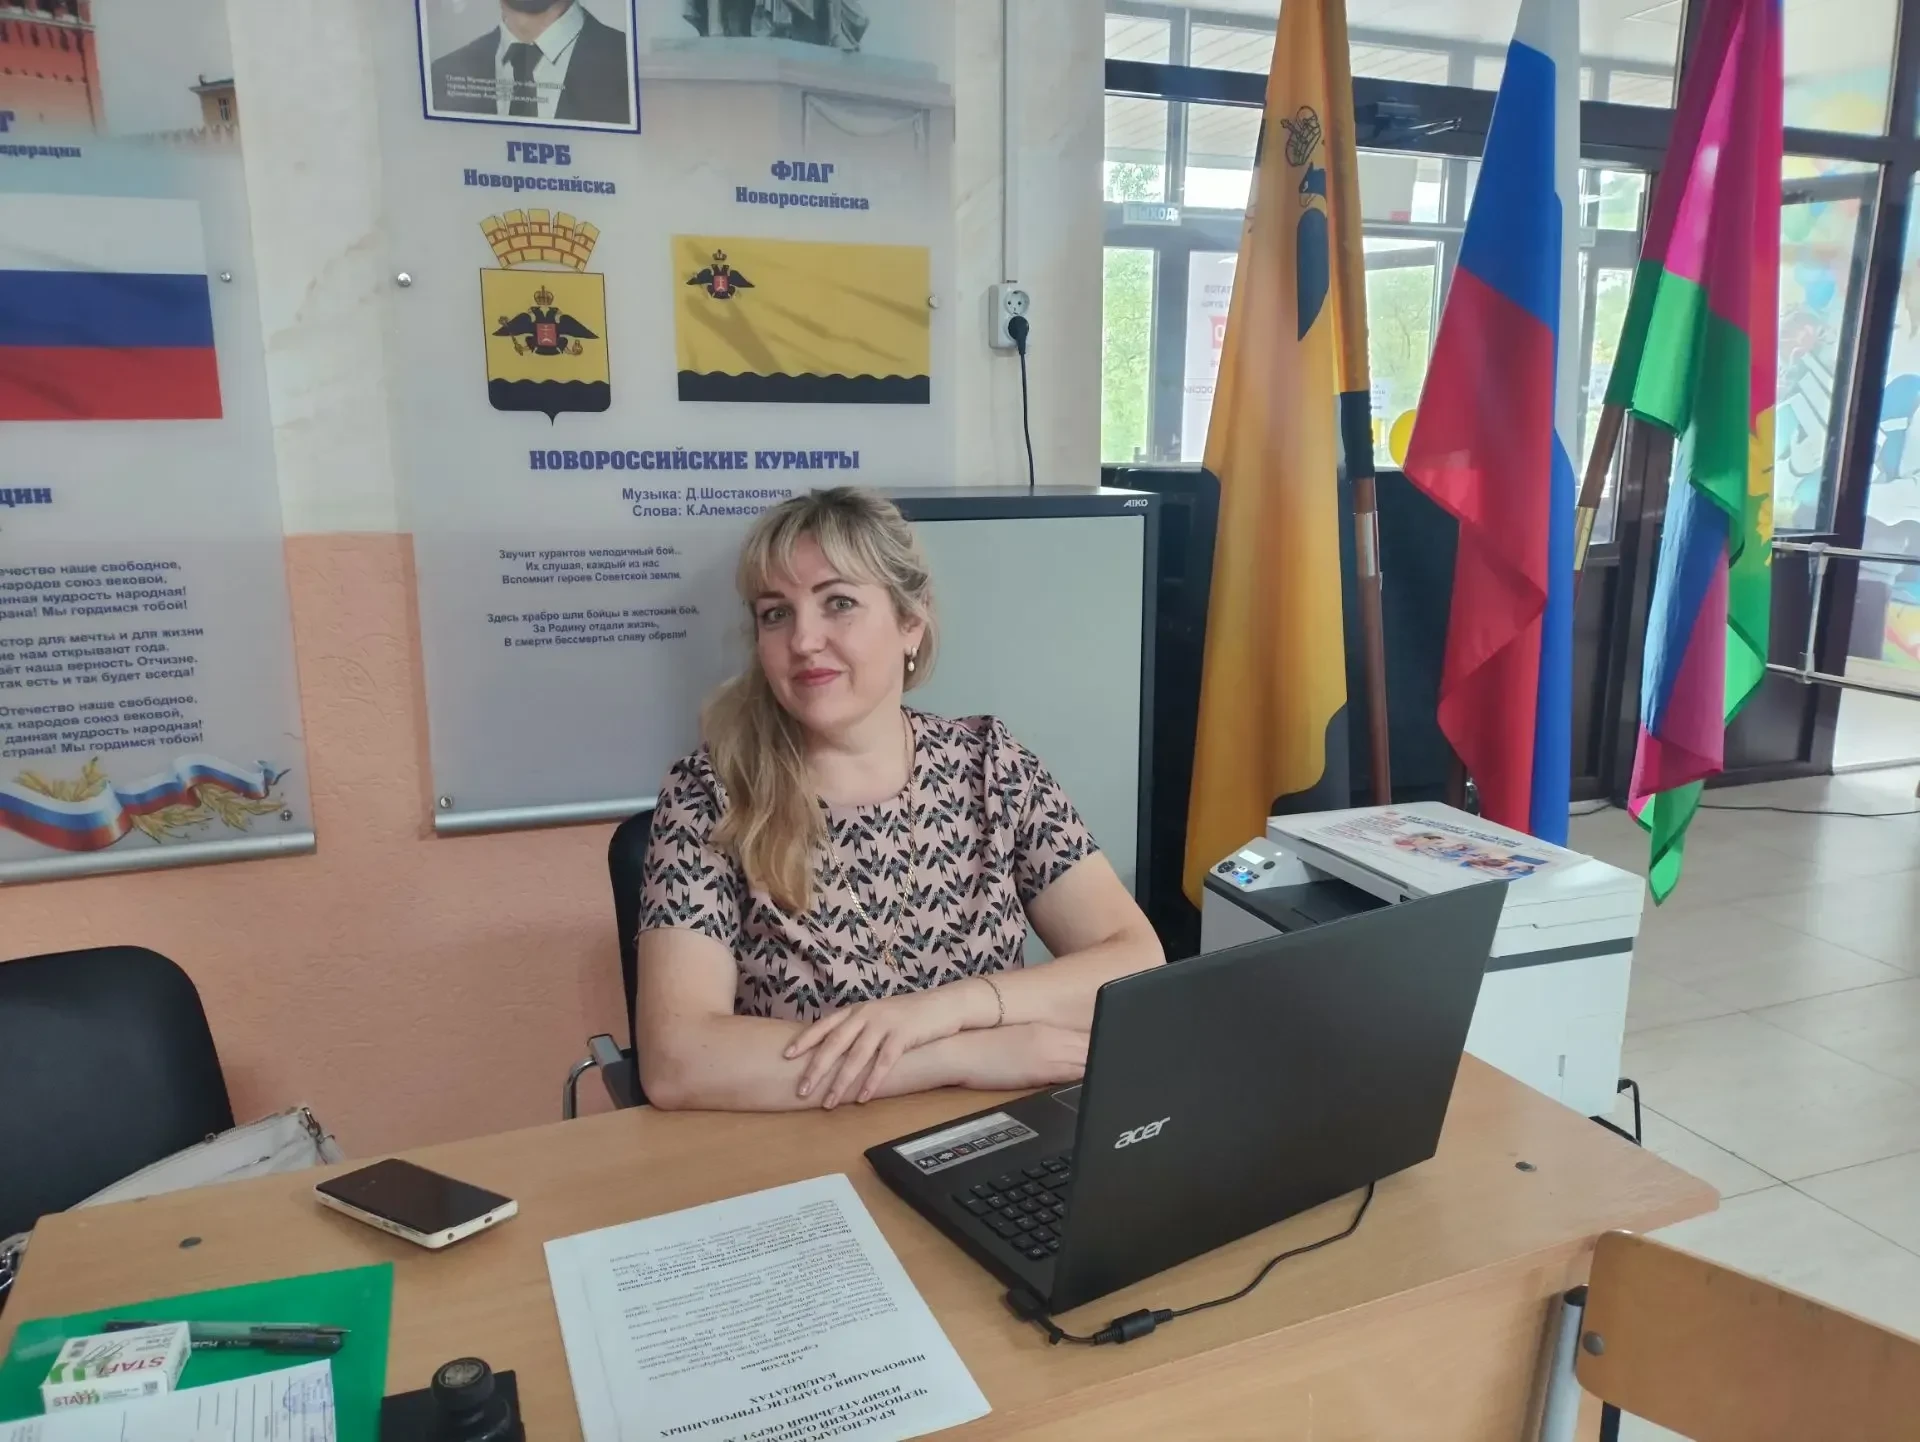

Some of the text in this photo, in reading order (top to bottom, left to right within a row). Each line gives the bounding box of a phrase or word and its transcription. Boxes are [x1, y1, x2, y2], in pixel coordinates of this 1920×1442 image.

[506, 141, 572, 166] ГЕРБ
[770, 160, 834, 183] ФЛАГ
[463, 169, 616, 195] Новороссийска
[736, 186, 870, 210] Новороссийска
[529, 447, 860, 470] НОВОРОССИЙСКИЕ КУРАНТЫ
[622, 486, 793, 502] Музыка: Д.Шостаковича
[632, 504, 682, 517] Слова:
[1123, 499, 1148, 508] AIKO
[499, 550, 535, 560] Звучит
[539, 549, 586, 560] курантов
[589, 546, 653, 557] мелодичный
[60, 563, 97, 574] наше
[101, 560, 182, 573] свободное,
[525, 559, 660, 572] Их слушая, каждый из нас
[65, 579, 101, 589] союз
[502, 574, 554, 585] Вспомнит
[557, 574, 592, 583] героев
[595, 572, 648, 582] Советской
[42, 590, 112, 605] мудрость
[116, 586, 186, 601] народная!
[42, 606, 67, 617] Мы
[71, 603, 138, 617] гордимся
[143, 600, 187, 612] тобой!
[487, 613, 519, 623] Здесь
[522, 611, 559, 623] храбро
[562, 611, 584, 620] шли
[586, 608, 620, 619] бойцы
[631, 606, 676, 617] жестокий
[533, 624, 545, 634] За
[548, 622, 586, 634] Родину
[589, 621, 624, 631] отдали
[38, 637, 65, 647] для
[69, 633, 115, 643] мечты
[119, 632, 128, 640] и
[132, 630, 158, 640] для
[162, 628, 204, 638] жизни
[504, 637, 512, 647] В
[515, 636, 552, 648] смерти
[555, 633, 615, 645] бессмертья
[618, 632, 645, 642] славу
[19, 651, 48, 660] нам
[52, 645, 131, 658] открывают
[25, 664, 63, 674] наша
[67, 660, 133, 673] верность
[26, 678, 58, 688] есть
[62, 677, 72, 685] и
[75, 675, 98, 685] так
[101, 671, 141, 684] будет
[145, 667, 195, 680] всегда!
[79, 700, 115, 712] наше
[17, 717, 80, 731] народов
[83, 714, 119, 725] союз
[123, 708, 184, 721] вековой,
[5, 719, 203, 745] данная мудрость народная!
[2, 732, 204, 759] страна! Мы гордимся тобой!
[1114, 1116, 1170, 1149] acer
[760, 1355, 804, 1372] АЛТУХОВ
[659, 1354, 926, 1438] ИНФОРМАЦИЯ О ЗАРЕГИСТРИРОВАННЫХ
[749, 1372, 837, 1404] КАНДИДАТАХ
[788, 1385, 902, 1429] ИЗБИРАТЕЛЬНЫЙ
[820, 1387, 928, 1430] ЧЕРНОМОРСКИЙ
[743, 1423, 785, 1441] ОКРУГ
